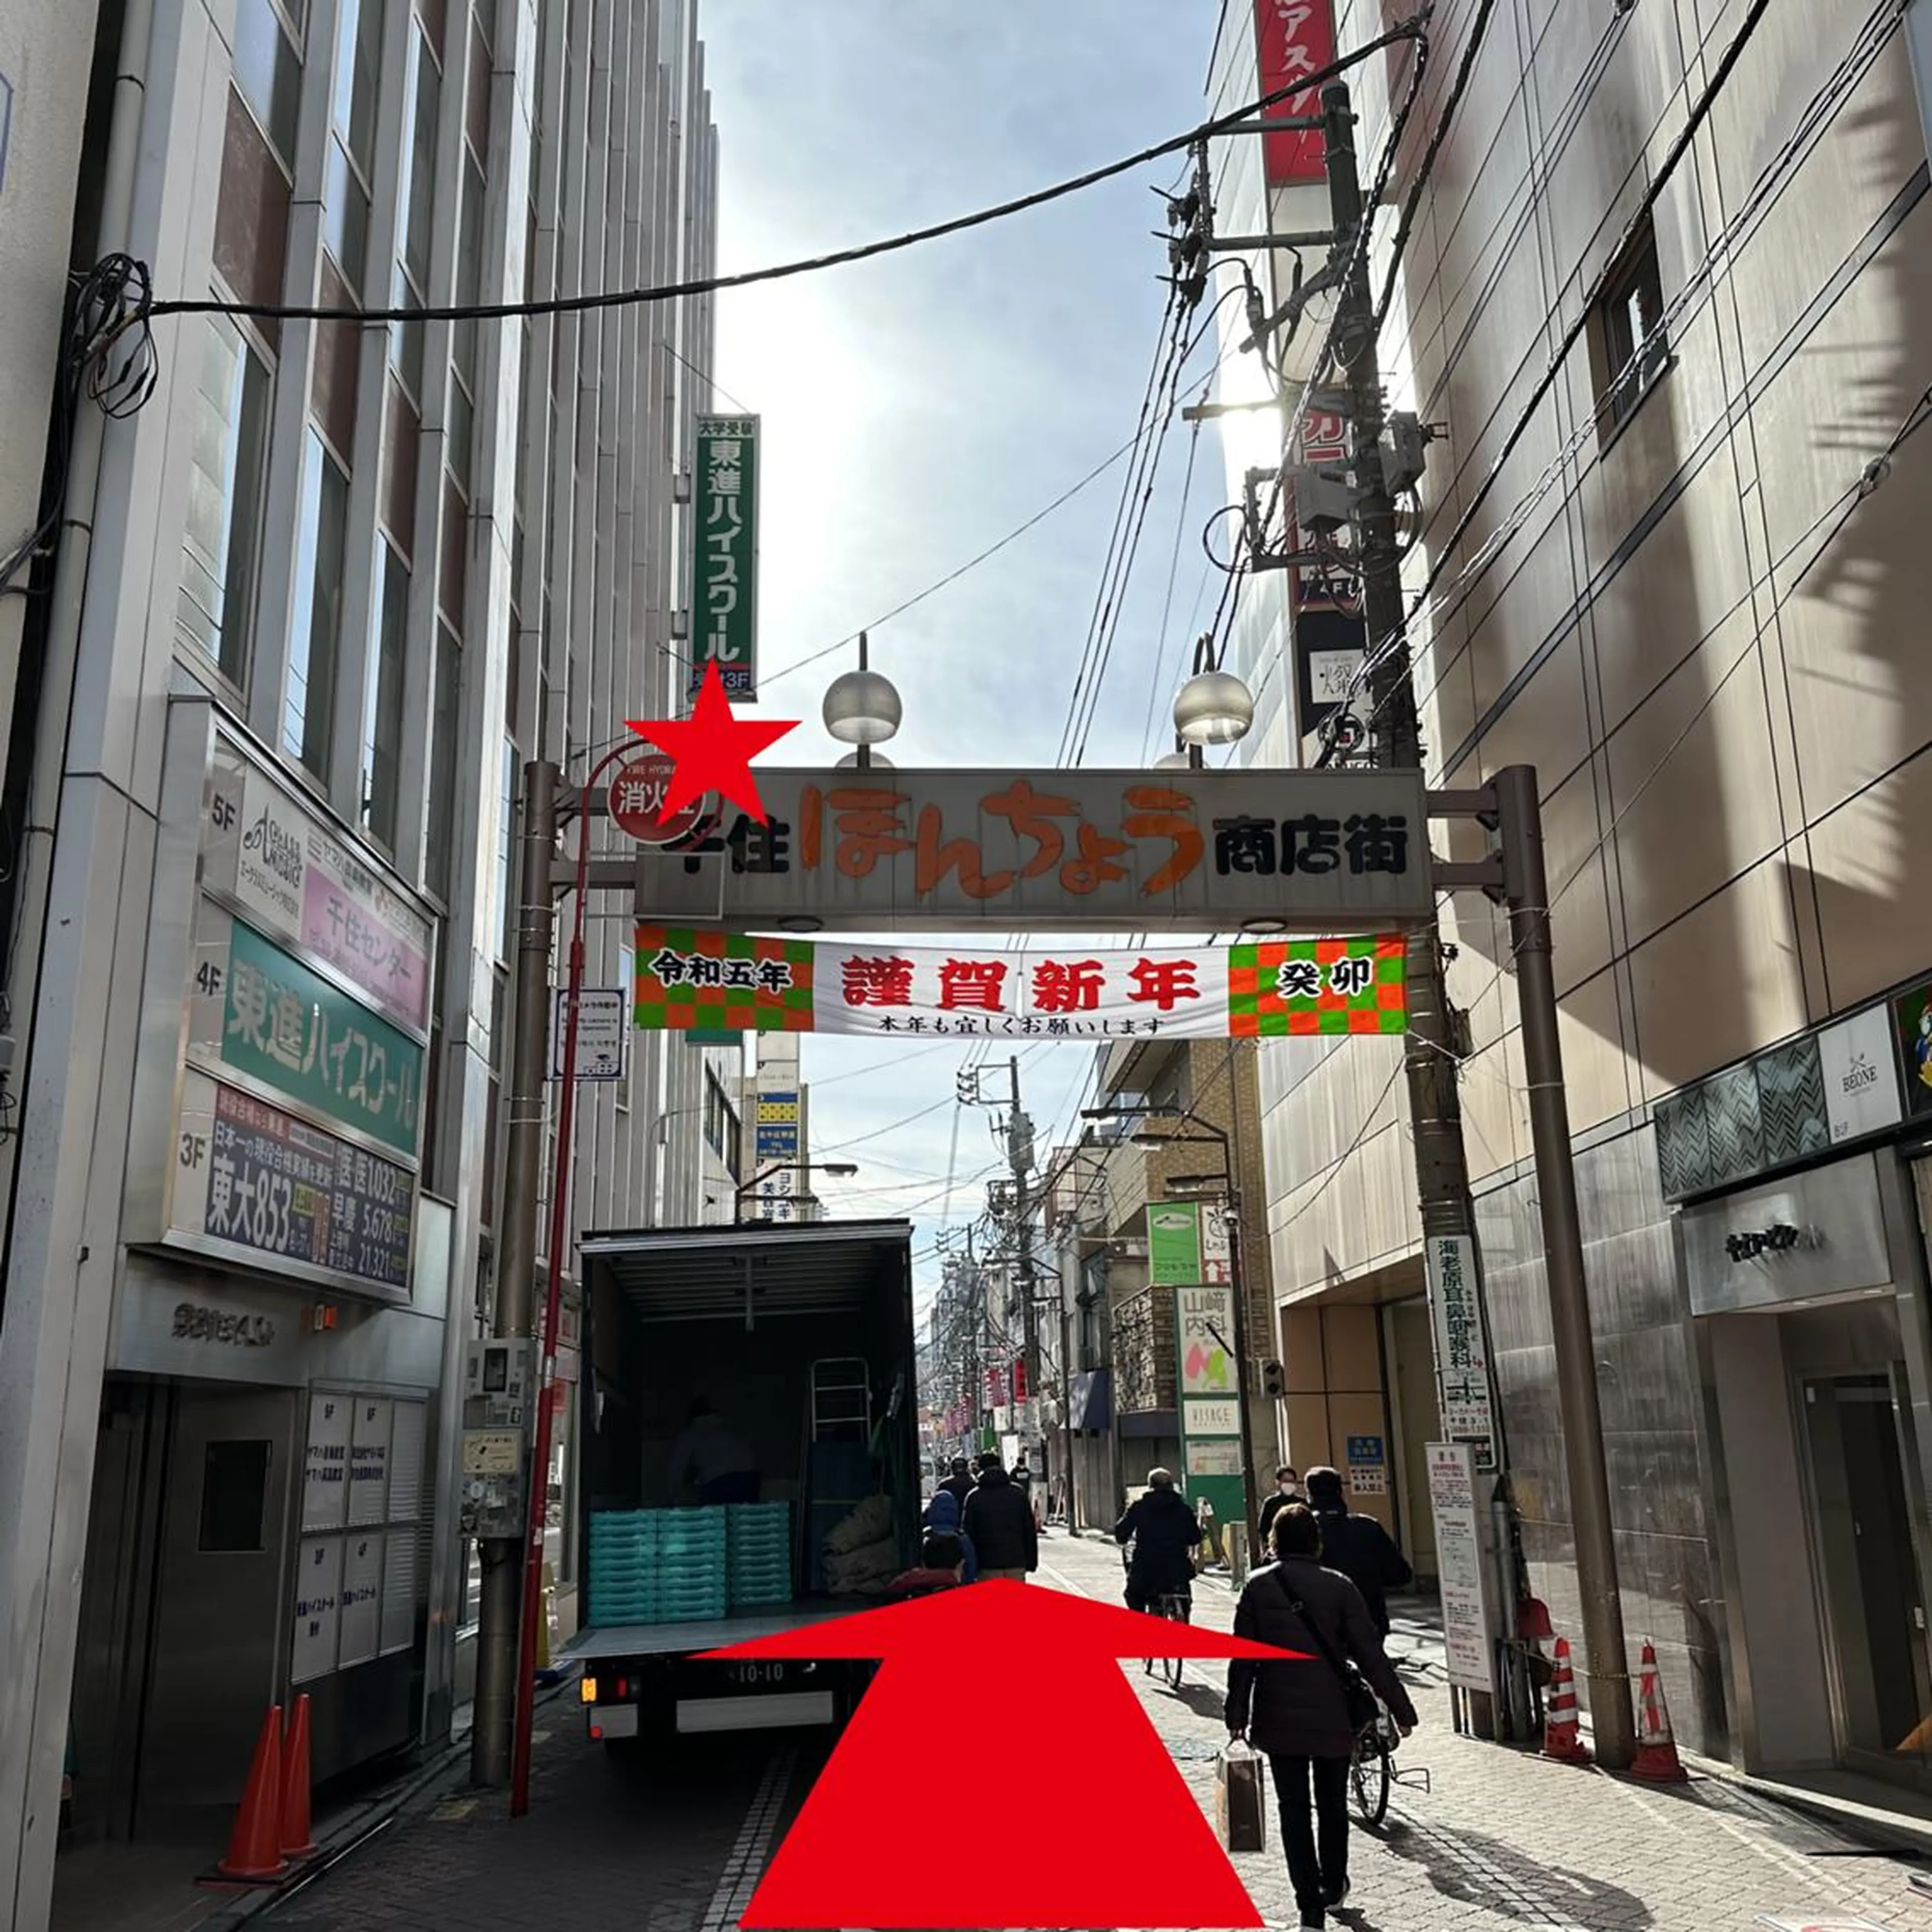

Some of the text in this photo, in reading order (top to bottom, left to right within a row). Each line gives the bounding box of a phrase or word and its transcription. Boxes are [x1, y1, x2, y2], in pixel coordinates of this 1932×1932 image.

[699, 422, 753, 437] 大学受験
[706, 440, 742, 662] 東進ハイスクール
[211, 794, 236, 831] 5F
[618, 780, 695, 815] 消火
[196, 961, 222, 996] 4F
[653, 950, 793, 994] 令和五年
[841, 955, 1200, 1012] 謹賀新年
[1277, 956, 1375, 1000] 癸卯
[878, 1014, 1165, 1036] 本年も宜しくお願いします
[226, 959, 414, 1131] 東進ハイスクール
[179, 1133, 206, 1169] 3F
[1185, 1314, 1227, 1337] 内科
